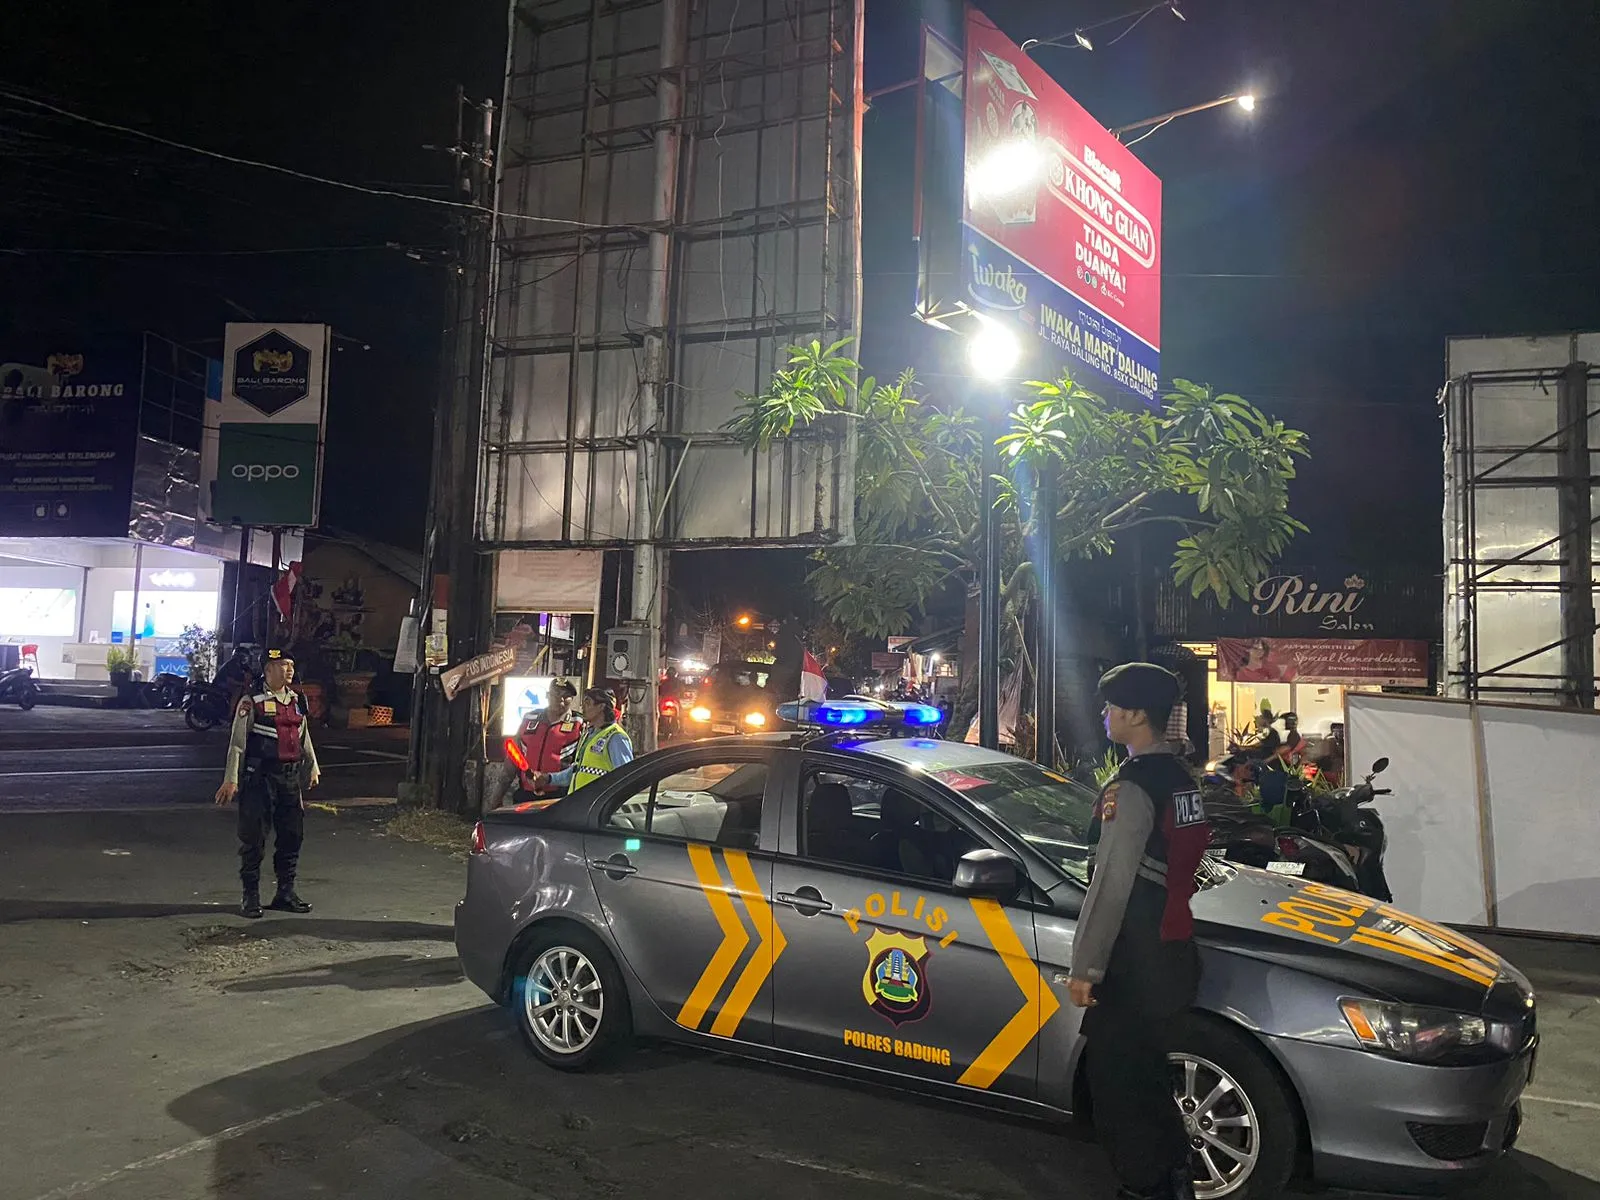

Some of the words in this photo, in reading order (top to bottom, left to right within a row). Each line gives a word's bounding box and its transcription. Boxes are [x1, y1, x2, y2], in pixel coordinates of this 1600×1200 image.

[1084, 145, 1122, 192] Biscuit
[1064, 165, 1113, 225] KHONG
[1115, 210, 1149, 255] GUAN
[1083, 223, 1120, 267] TIADA
[1075, 241, 1126, 294] DUANYA!
[1040, 303, 1082, 347] IWAKA
[1084, 330, 1116, 366] MART
[1118, 351, 1158, 392] DALUNG
[1050, 332, 1071, 353] RAYA
[1071, 343, 1101, 369] DALUNG
[1101, 360, 1113, 377] NO.
[1129, 377, 1154, 401] DALUNG
[51, 383, 125, 398] BARONG
[231, 463, 300, 482] oppo
[1251, 574, 1365, 615] Rini
[1318, 615, 1374, 630] Salon
[480, 648, 514, 673] INDONESIA
[1293, 651, 1336, 667] Special
[1337, 652, 1420, 664] Kemerdekaan
[841, 891, 960, 949] POLISI
[843, 1028, 892, 1056] POLRES
[894, 1038, 951, 1067] BADUNG
